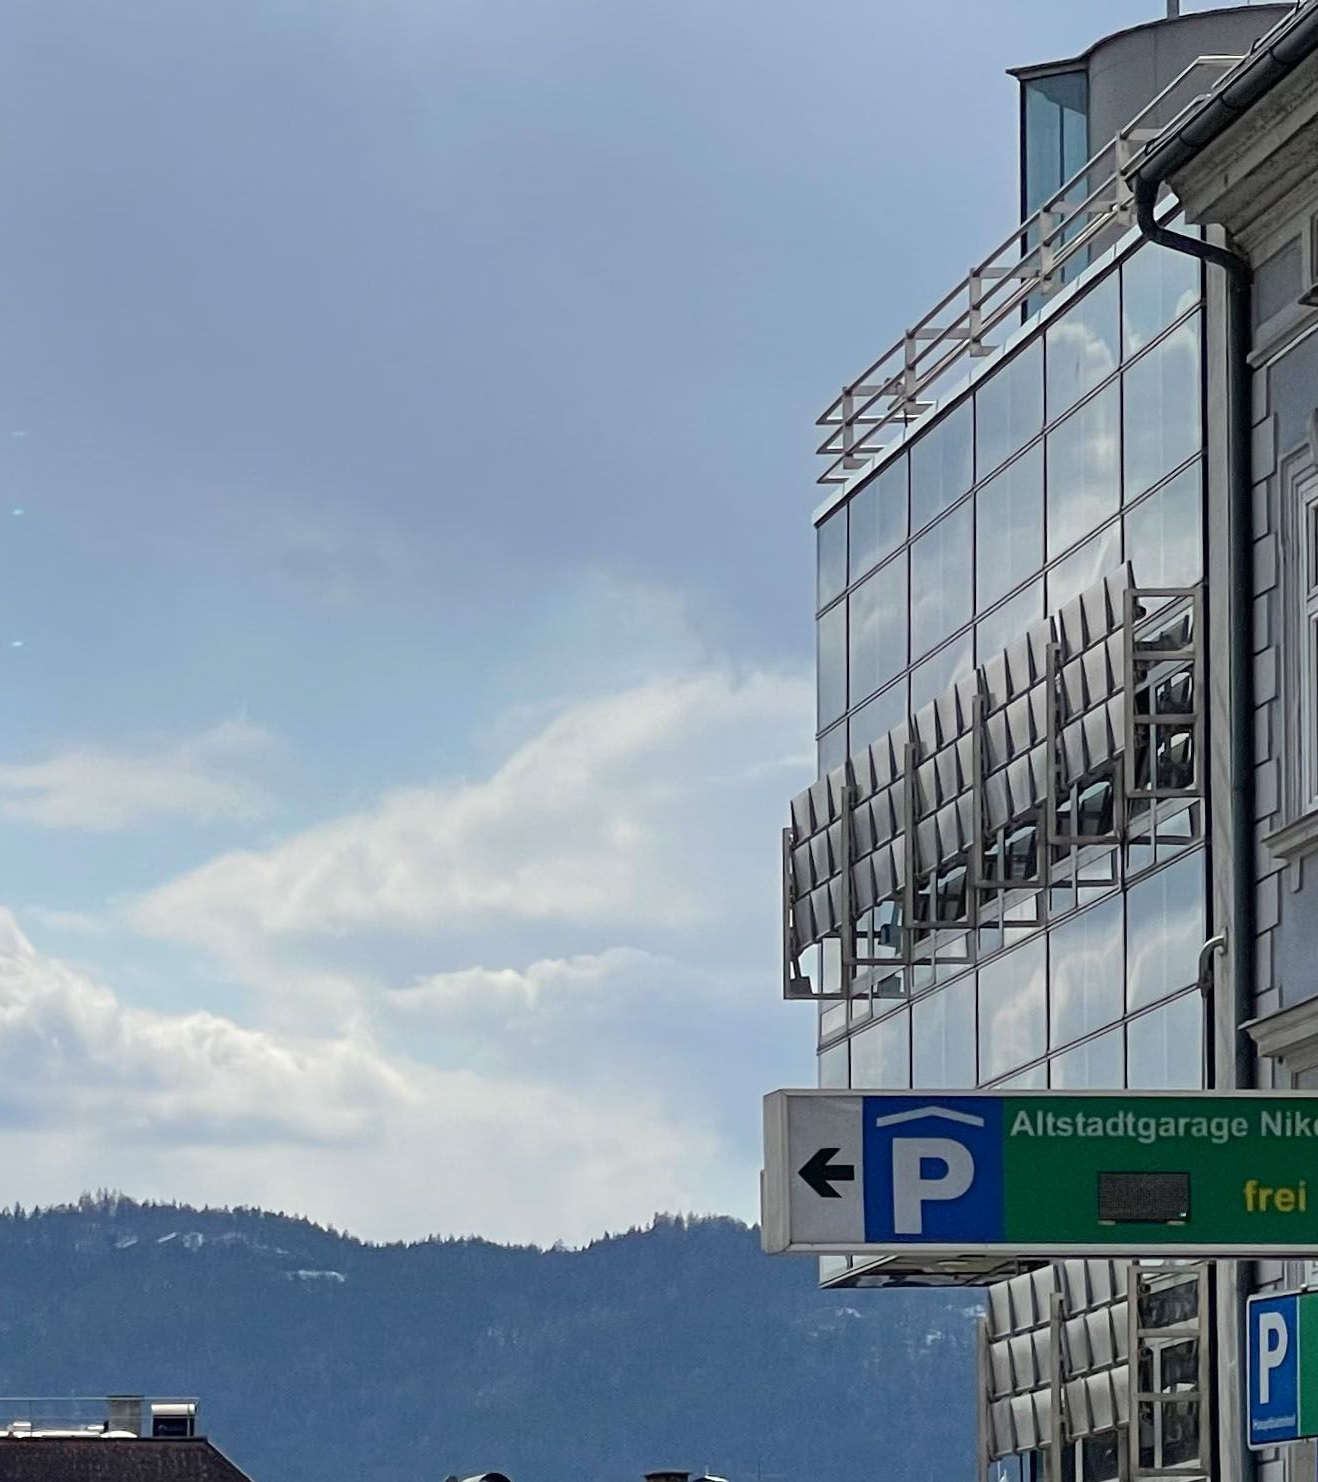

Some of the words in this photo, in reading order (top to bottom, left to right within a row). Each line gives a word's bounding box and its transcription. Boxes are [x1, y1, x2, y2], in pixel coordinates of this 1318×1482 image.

[1010, 1110, 1249, 1144] Altstadtgarage
[1261, 1110, 1318, 1137] Nik
[892, 1137, 975, 1235] P
[1244, 1179, 1307, 1213] frei
[1259, 1312, 1289, 1405] P
